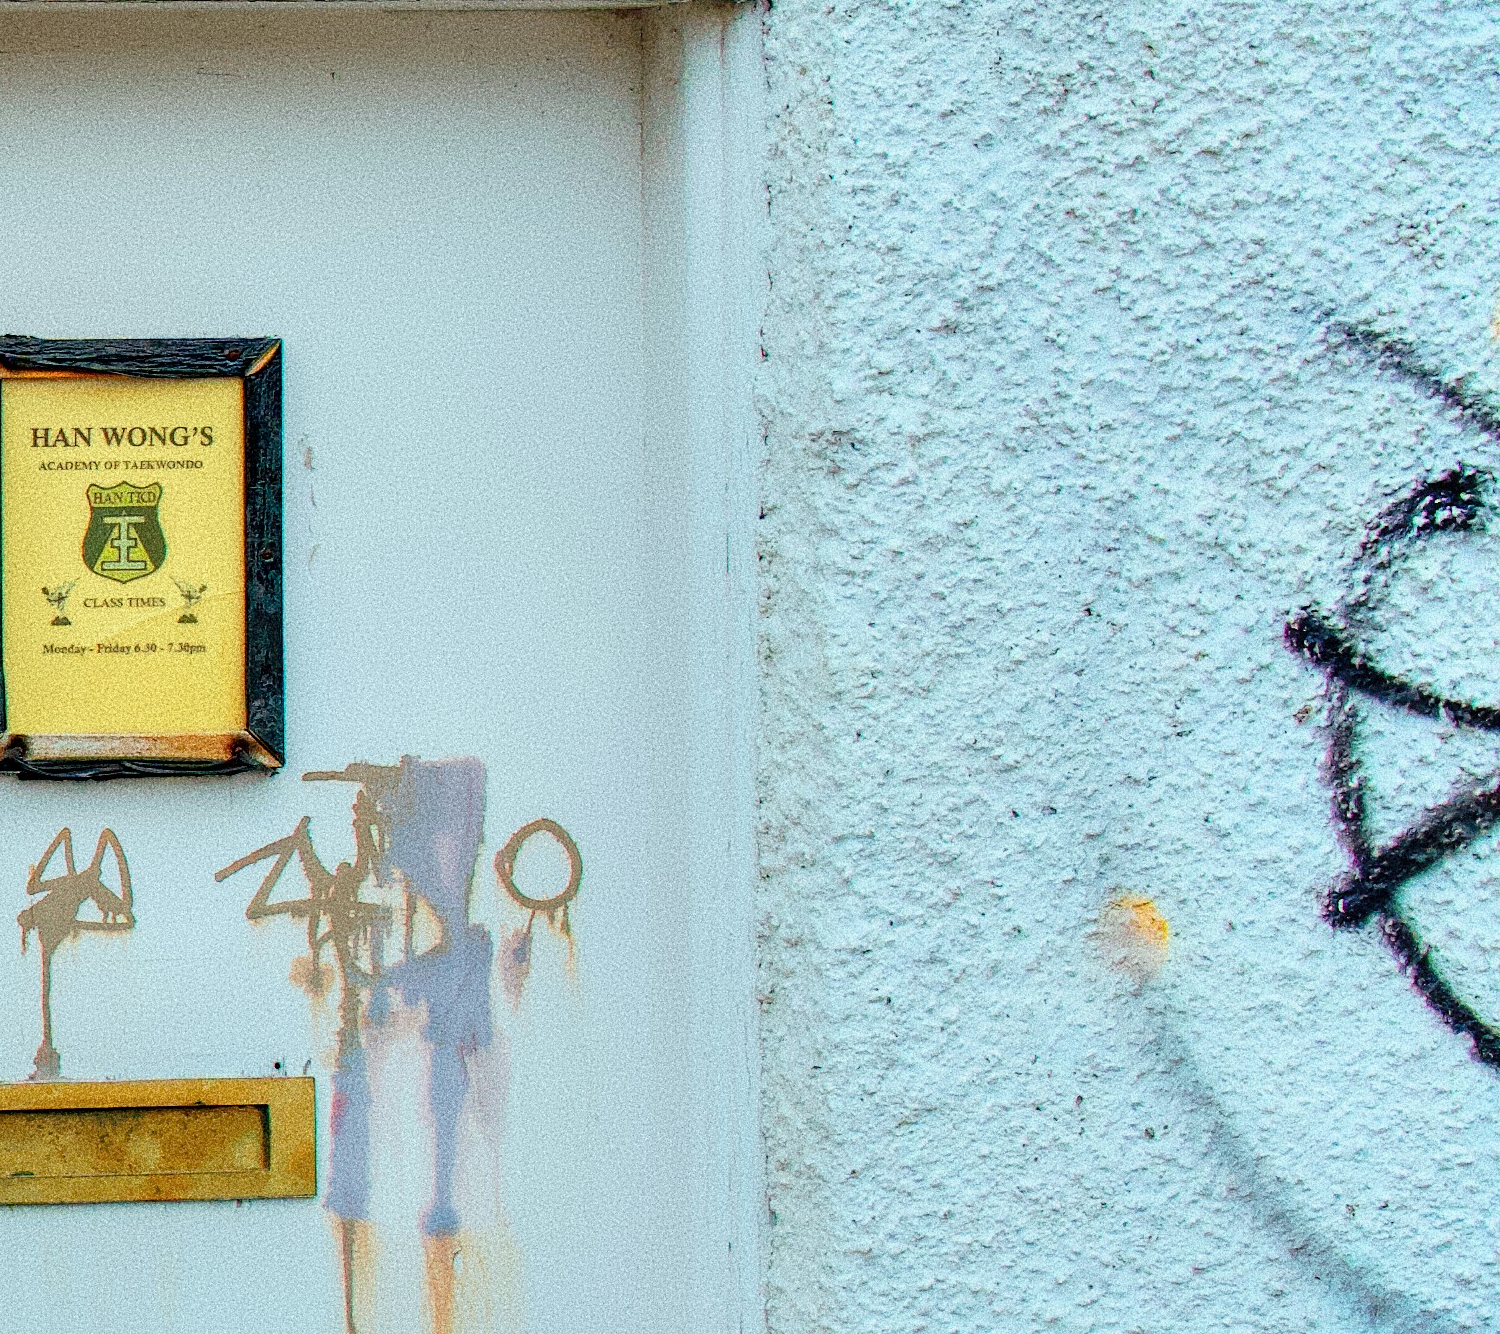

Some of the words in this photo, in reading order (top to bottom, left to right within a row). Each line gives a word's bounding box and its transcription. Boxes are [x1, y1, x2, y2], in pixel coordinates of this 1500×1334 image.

[30, 427, 93, 448] HAN
[99, 426, 215, 447] WONG'S
[38, 460, 100, 470] ACADEMY
[104, 460, 120, 470] OF
[124, 460, 204, 470] TAEKWONDO
[93, 492, 124, 504] HAN
[127, 492, 157, 504] TKD
[83, 597, 124, 608] CLASS
[127, 597, 166, 608] TIMES
[42, 644, 86, 655] Monday
[96, 643, 132, 655] Friday
